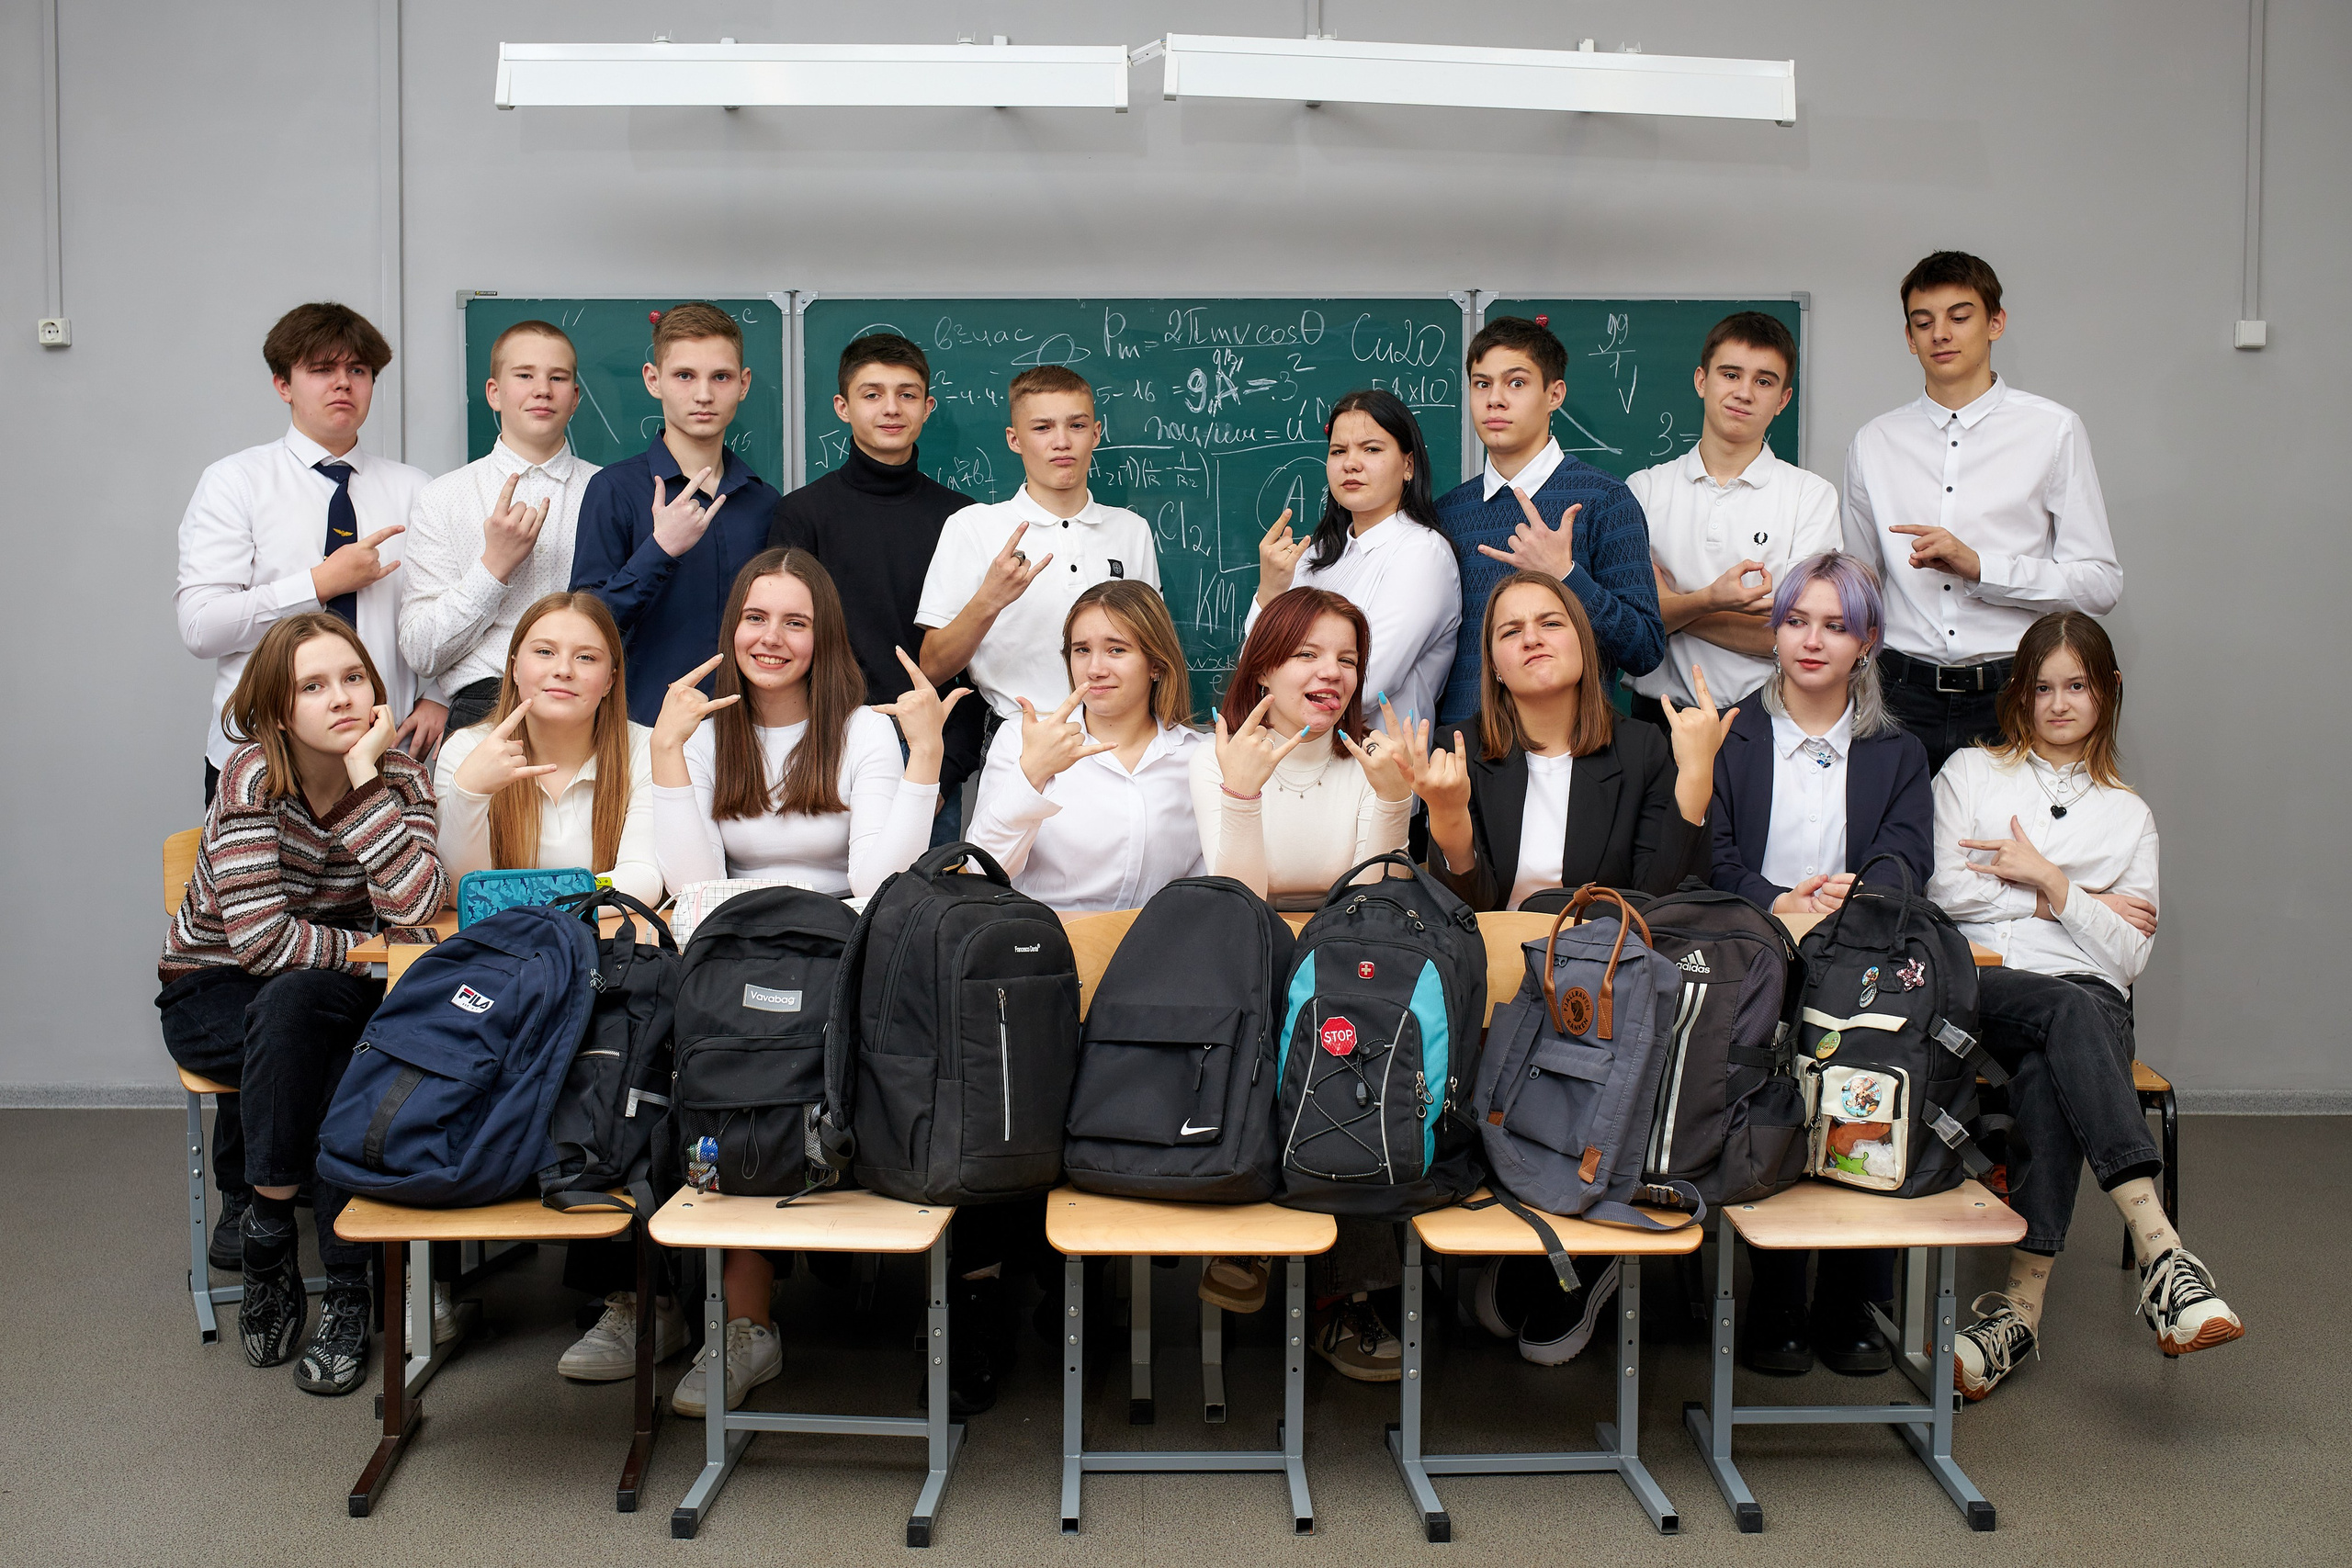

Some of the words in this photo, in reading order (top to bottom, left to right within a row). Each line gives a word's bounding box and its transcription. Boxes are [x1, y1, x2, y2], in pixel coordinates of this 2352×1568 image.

[1675, 961, 1711, 974] adidas
[458, 987, 491, 1010] FILA
[750, 990, 796, 1006] Vavabag
[1323, 1029, 1353, 1043] STOP
